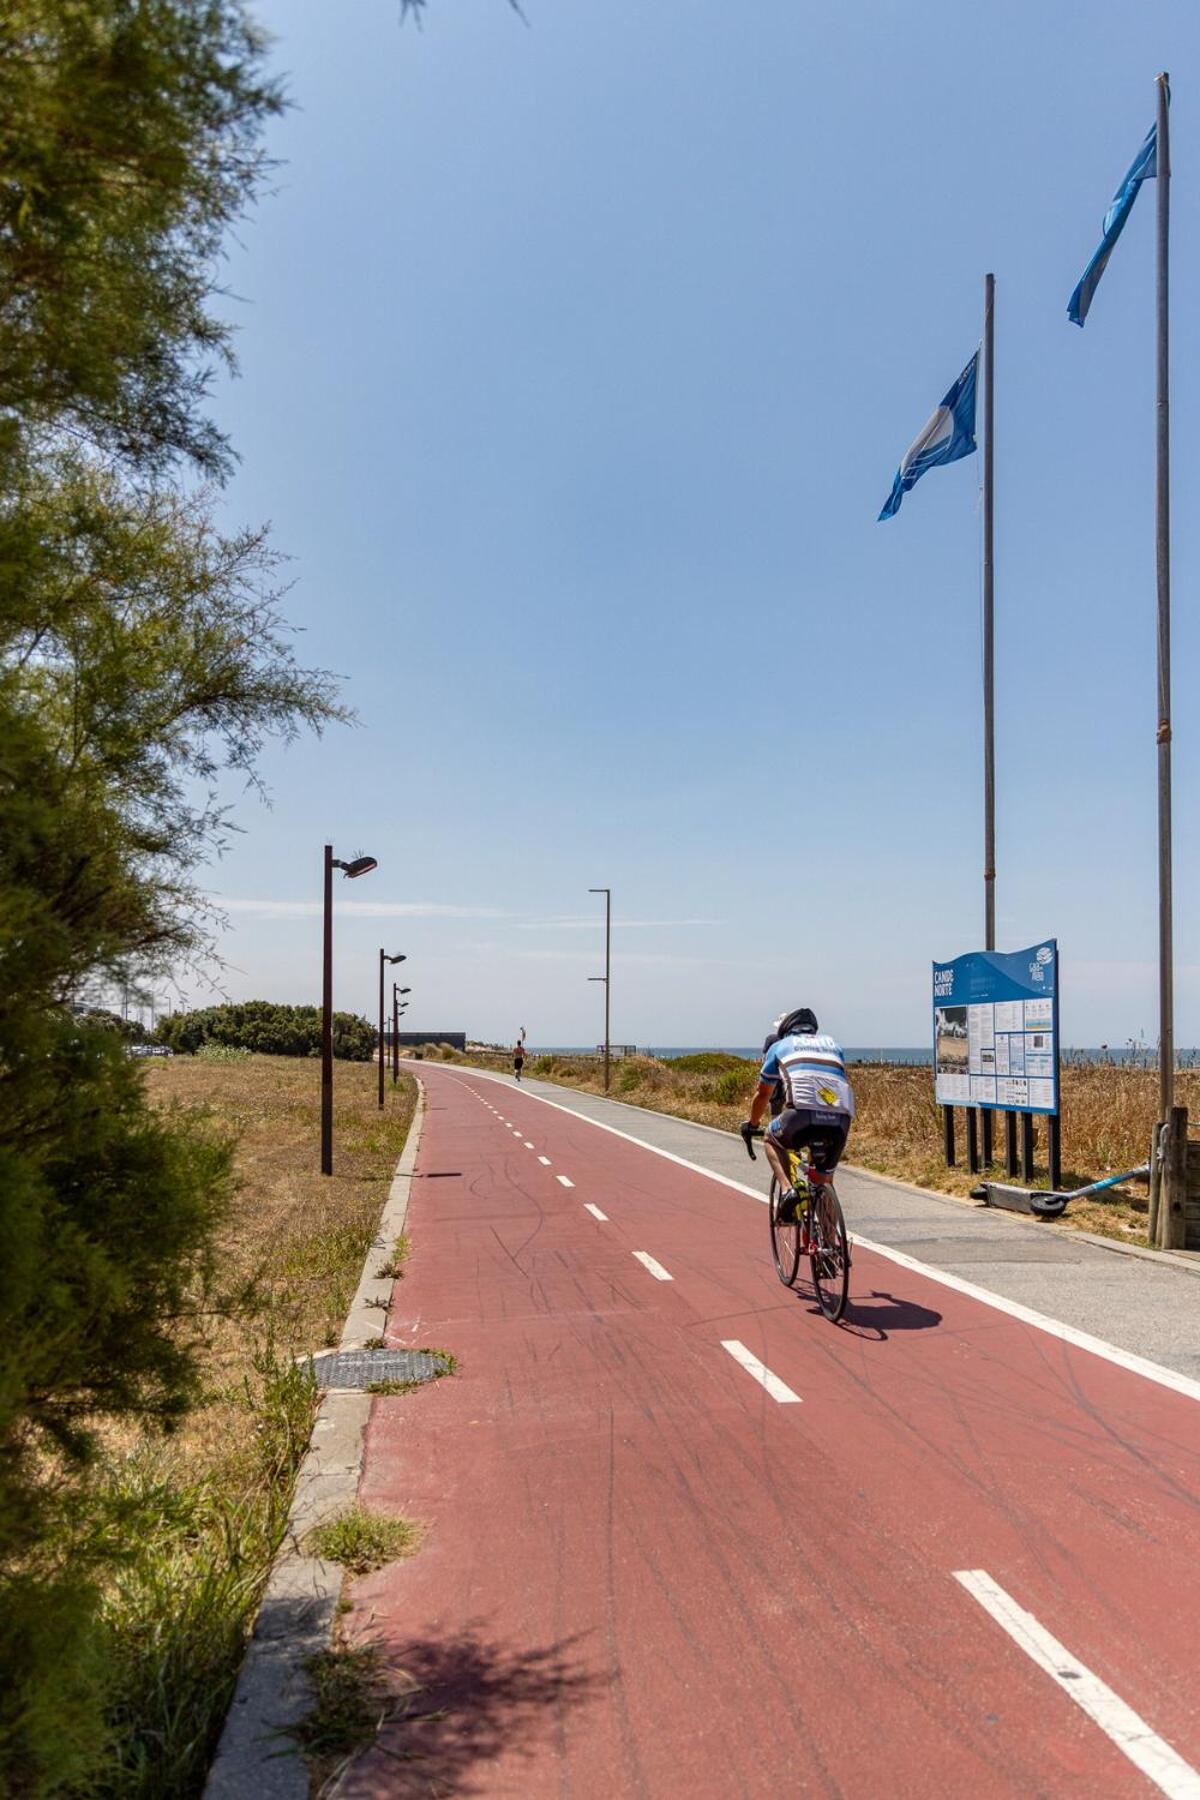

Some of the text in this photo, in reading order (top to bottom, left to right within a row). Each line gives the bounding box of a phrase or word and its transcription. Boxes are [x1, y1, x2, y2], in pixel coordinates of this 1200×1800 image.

[935, 983, 953, 997] NORTE
[793, 1037, 836, 1050] PORTO
[794, 1046, 820, 1054] Cycling
